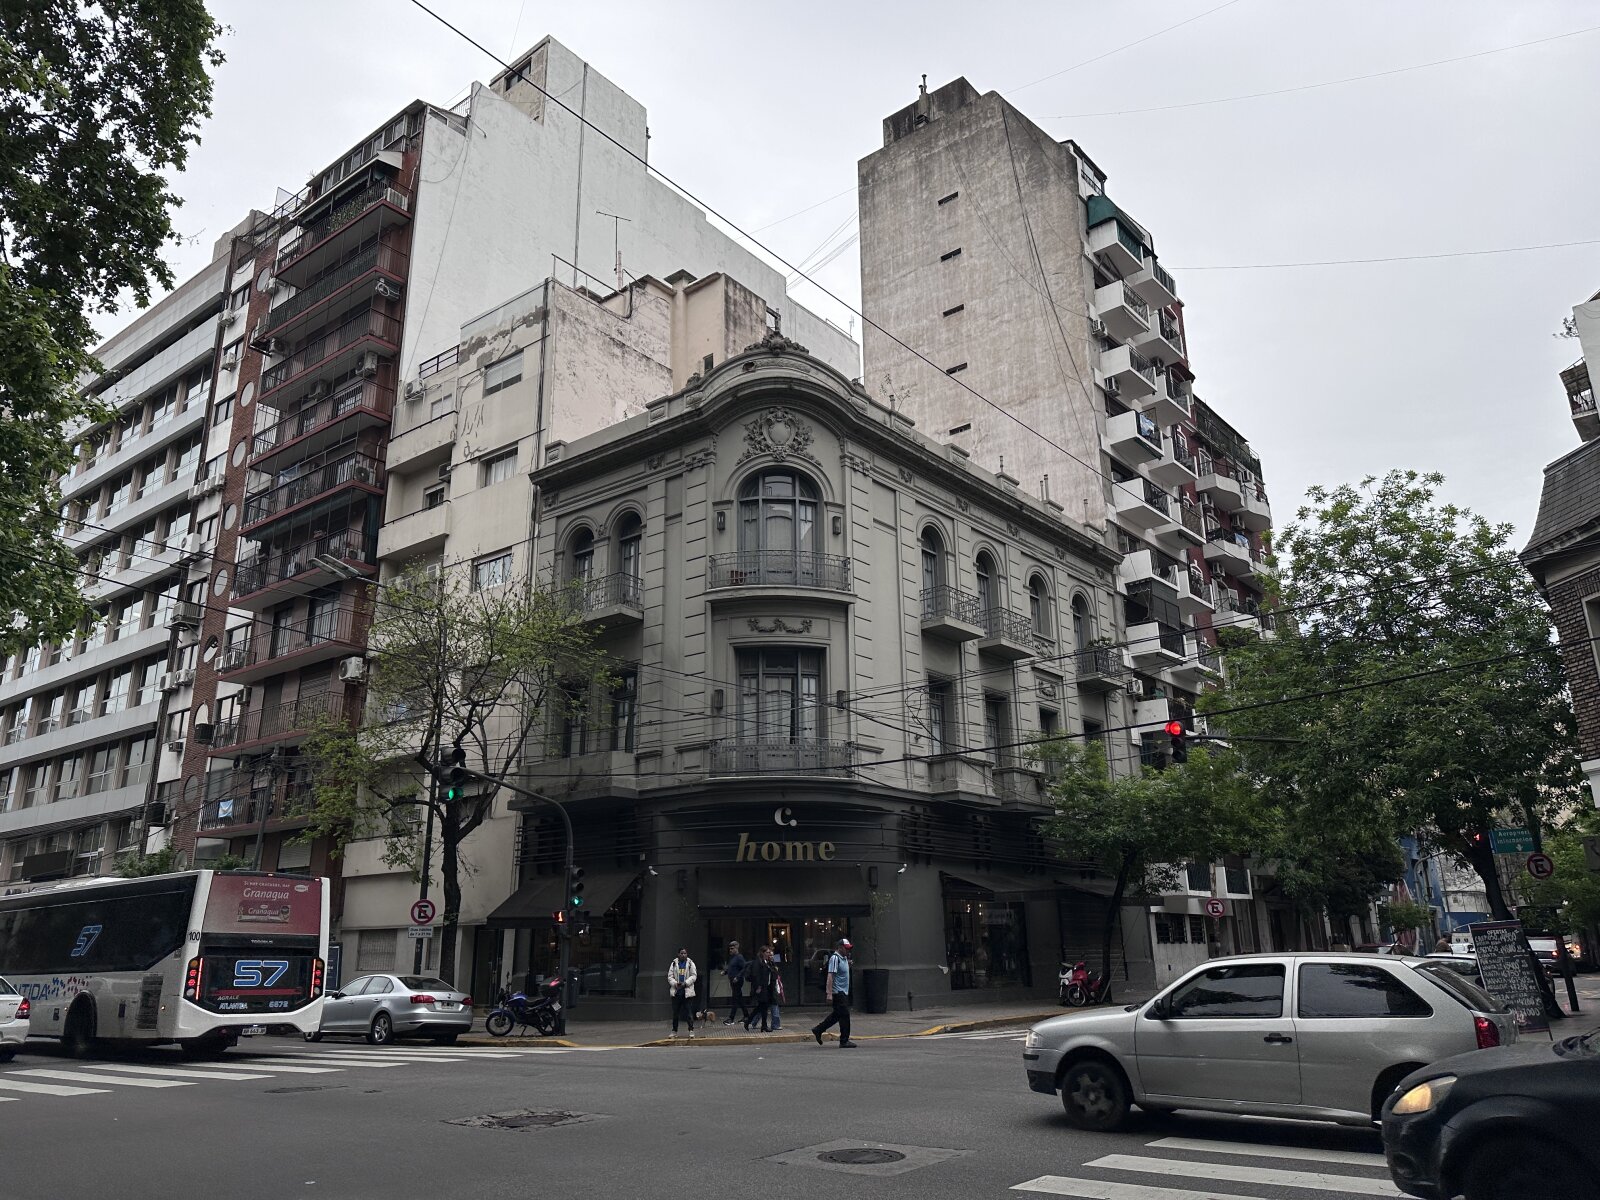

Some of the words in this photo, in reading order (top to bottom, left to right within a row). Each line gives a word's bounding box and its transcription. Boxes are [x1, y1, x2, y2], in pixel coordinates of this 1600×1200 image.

[736, 832, 835, 862] home
[243, 887, 290, 900] Granagua
[248, 907, 279, 916] Granagua
[70, 925, 103, 957] 57
[189, 931, 200, 941] 100
[233, 960, 289, 987] 57
[13, 983, 48, 1000] NTIDA
